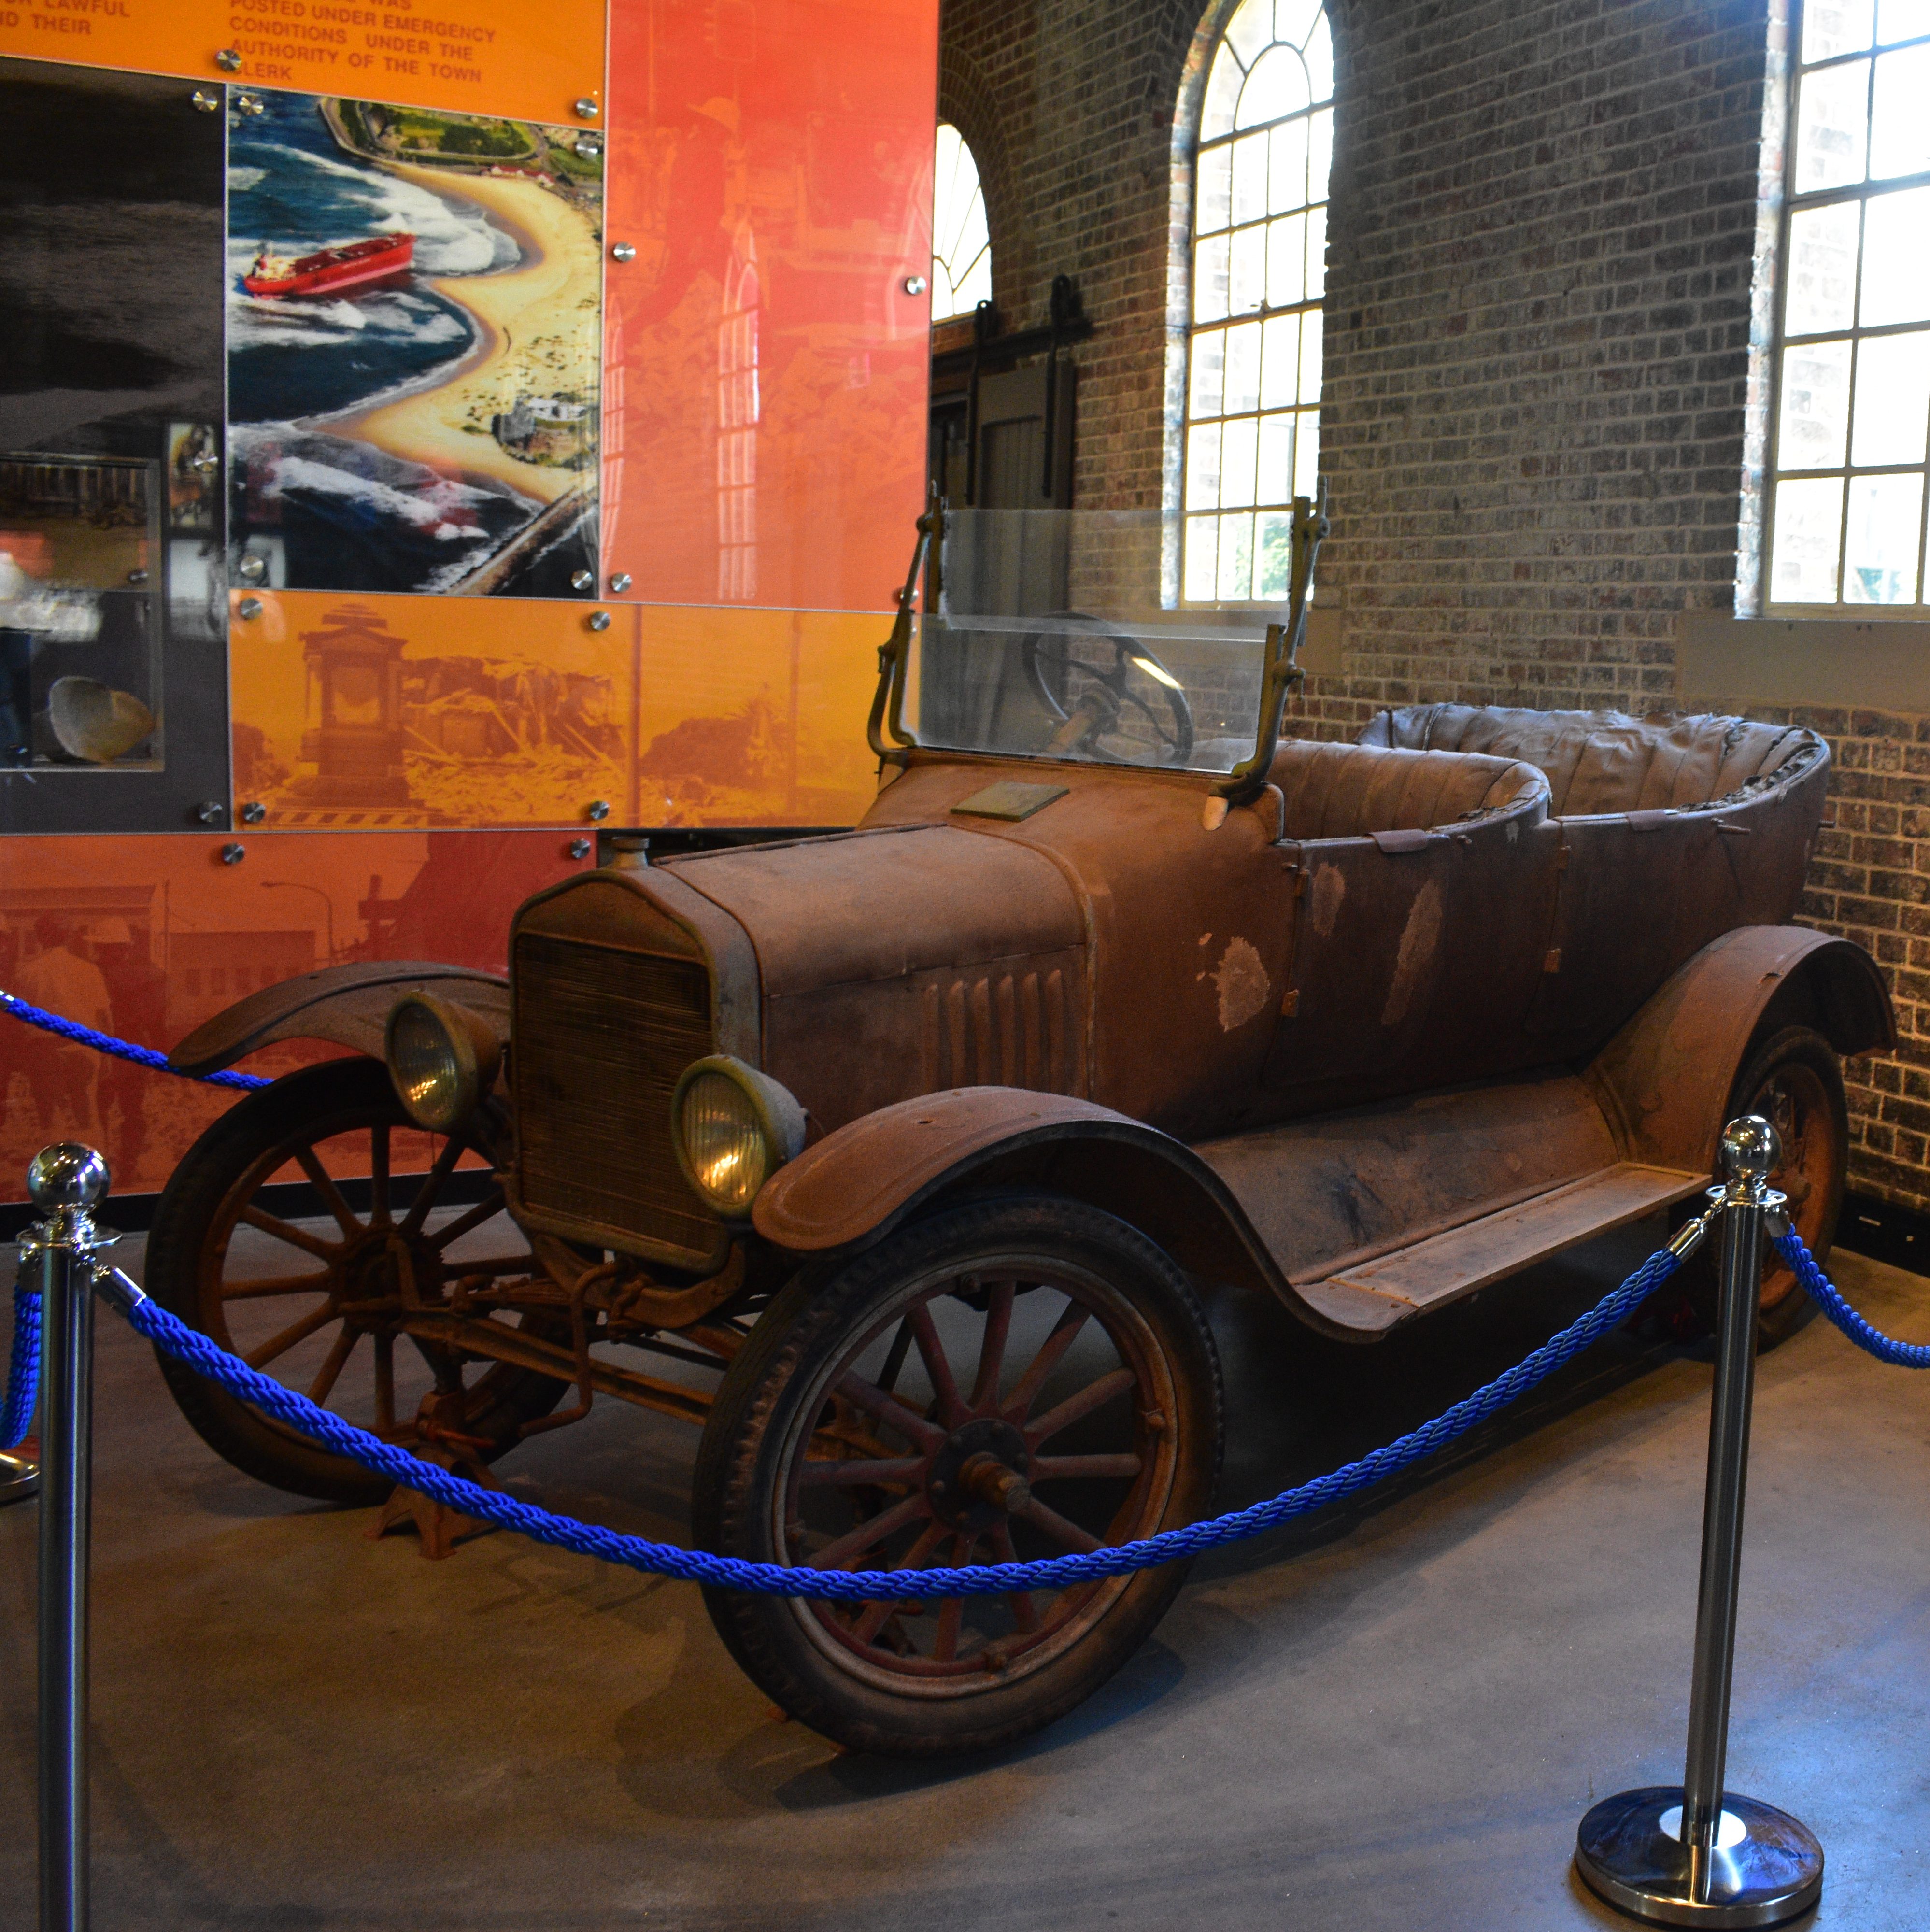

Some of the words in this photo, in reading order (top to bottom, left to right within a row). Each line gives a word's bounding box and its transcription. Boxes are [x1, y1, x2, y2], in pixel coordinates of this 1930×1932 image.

[31, 13, 92, 35] THEIR
[230, 16, 347, 44] CONDITIONS
[366, 34, 430, 54] UNDER
[440, 43, 473, 61] THE
[312, 5, 376, 26] UNDER
[383, 14, 496, 43] EMERGENCY
[232, 38, 338, 65] AUTHORITY
[348, 52, 375, 68] OF
[383, 57, 420, 75] THE
[429, 61, 482, 83] TOWN
[234, 61, 292, 80] LERK
